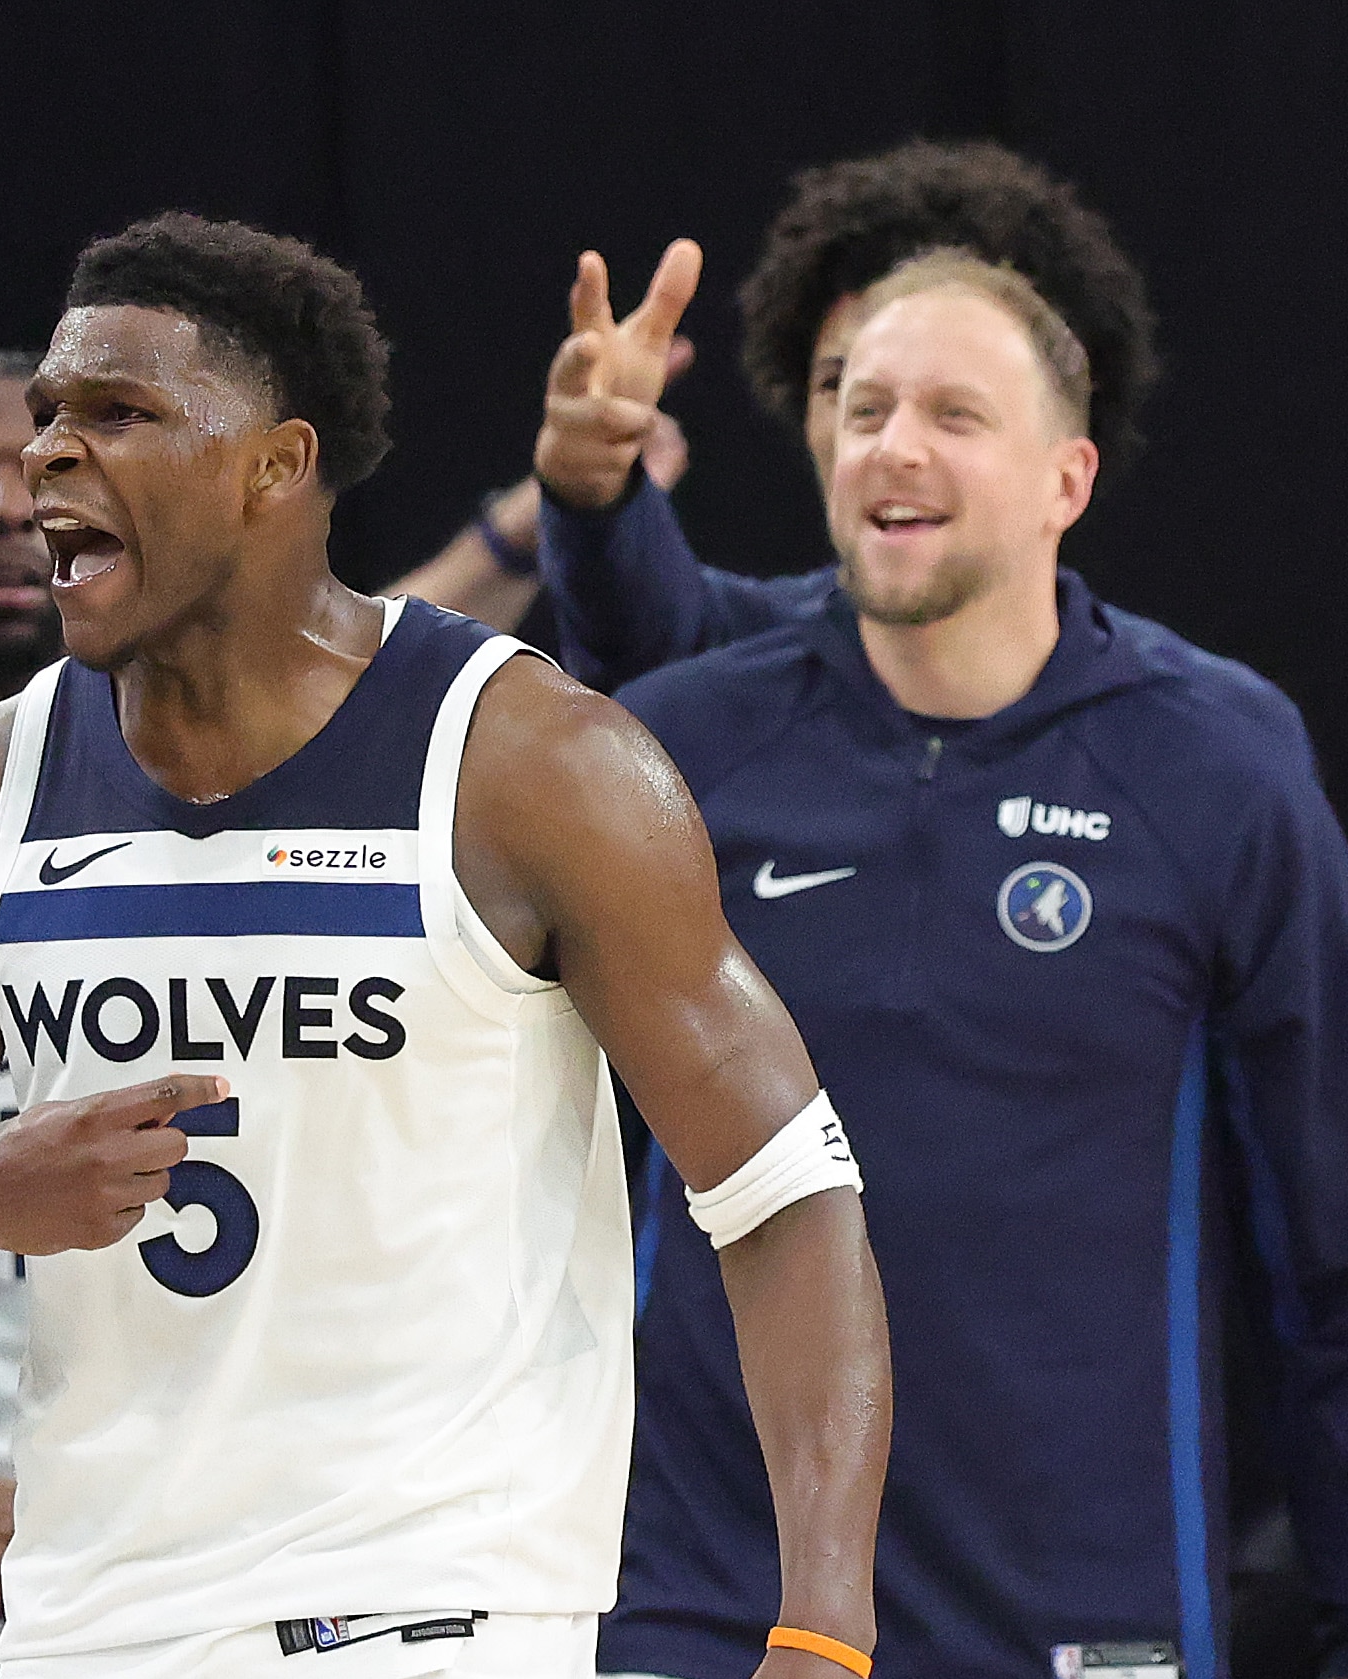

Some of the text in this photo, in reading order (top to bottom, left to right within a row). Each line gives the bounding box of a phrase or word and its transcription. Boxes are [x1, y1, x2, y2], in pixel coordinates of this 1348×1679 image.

[1030, 802, 1112, 841] UHC
[289, 844, 387, 869] sezzle
[1, 975, 407, 1067] WOLVES
[138, 1095, 260, 1298] 5
